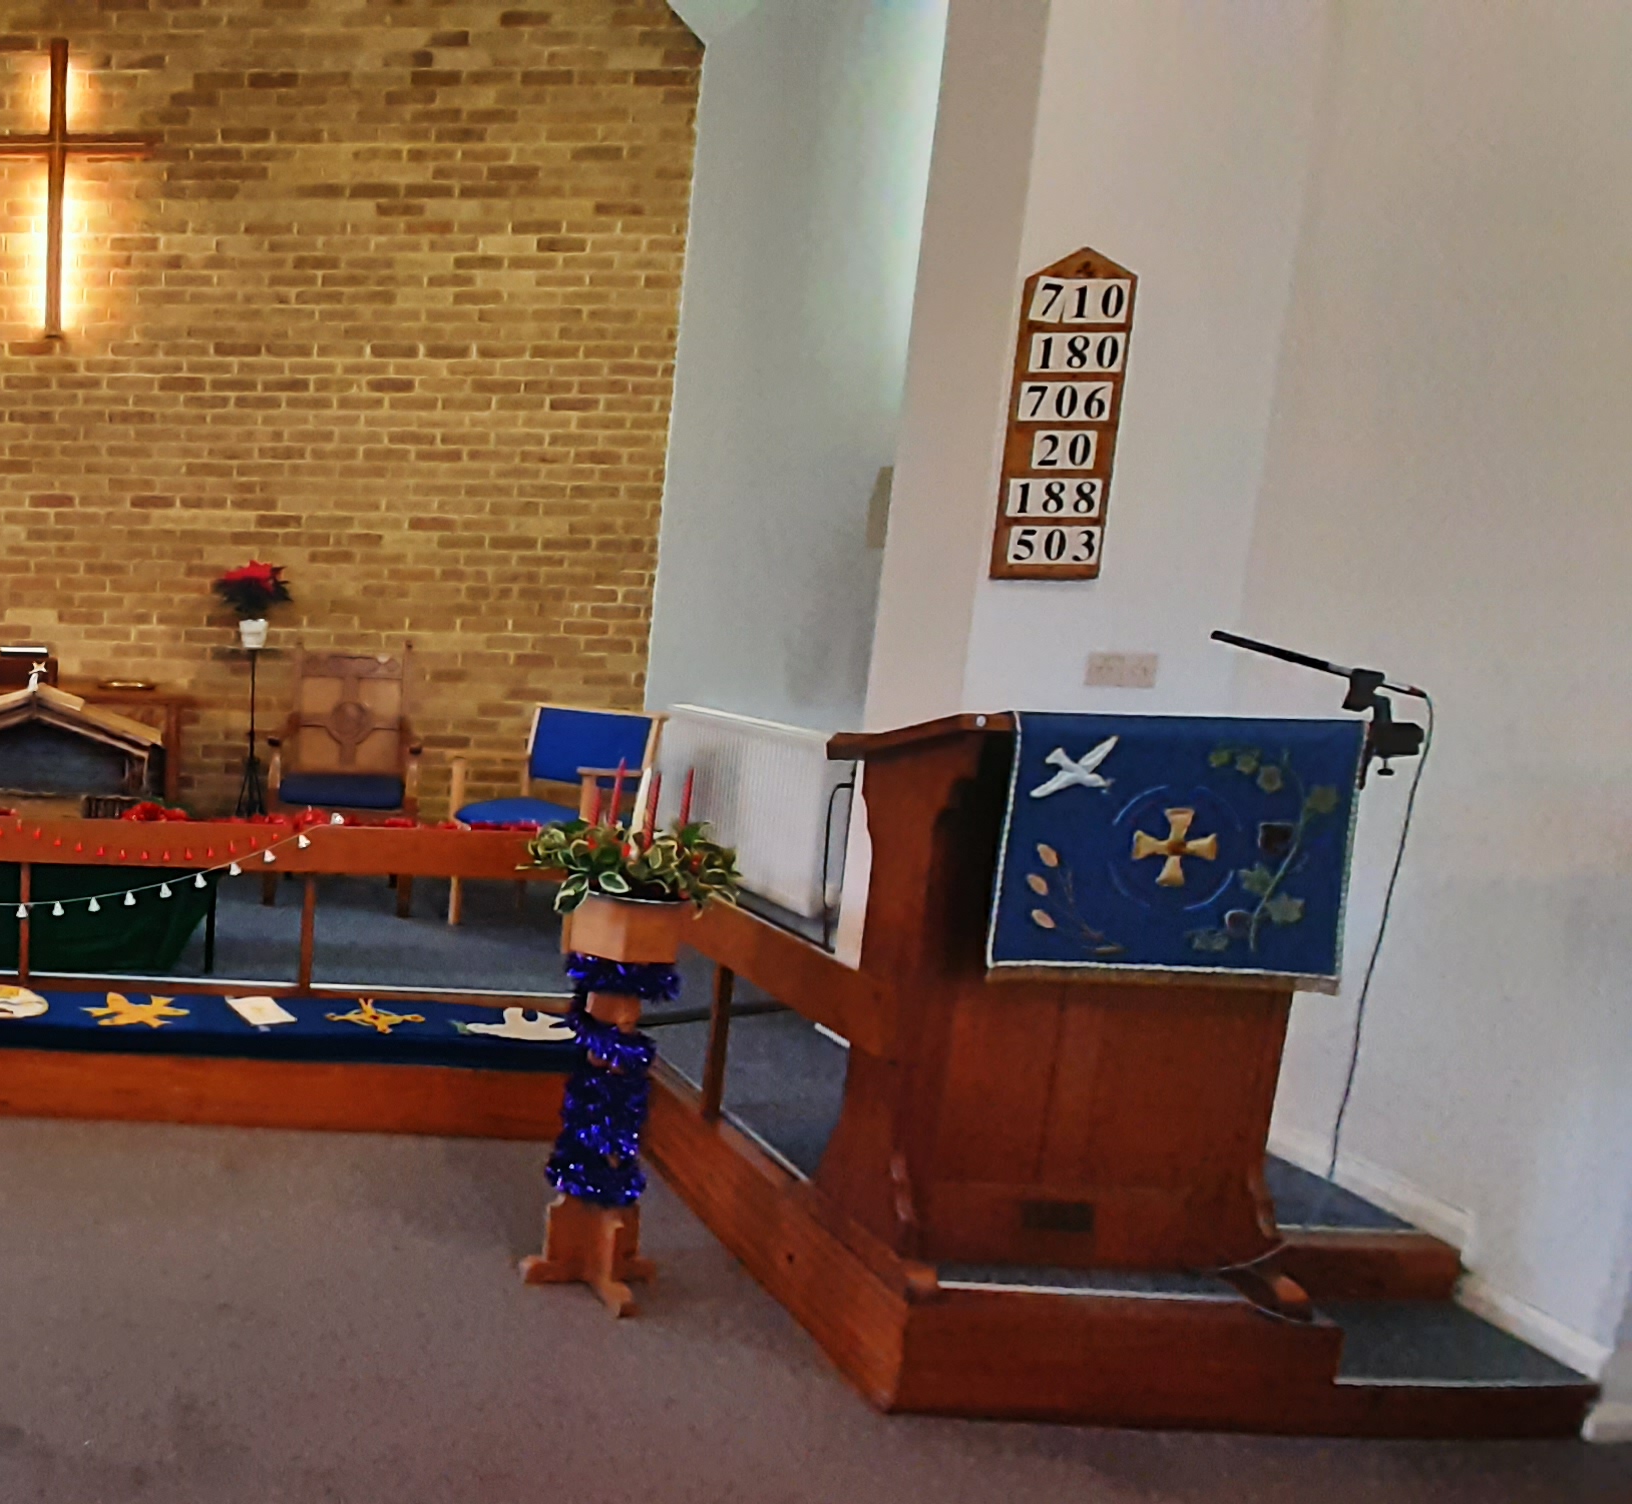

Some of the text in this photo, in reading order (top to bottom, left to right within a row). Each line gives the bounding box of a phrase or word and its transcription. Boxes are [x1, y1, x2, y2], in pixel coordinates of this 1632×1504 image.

[1040, 282, 1125, 319] 710
[1039, 335, 1119, 370] 180
[1026, 384, 1109, 419] 706
[1037, 433, 1092, 467] 20
[1017, 480, 1097, 514] 188
[1013, 528, 1095, 562] 503
